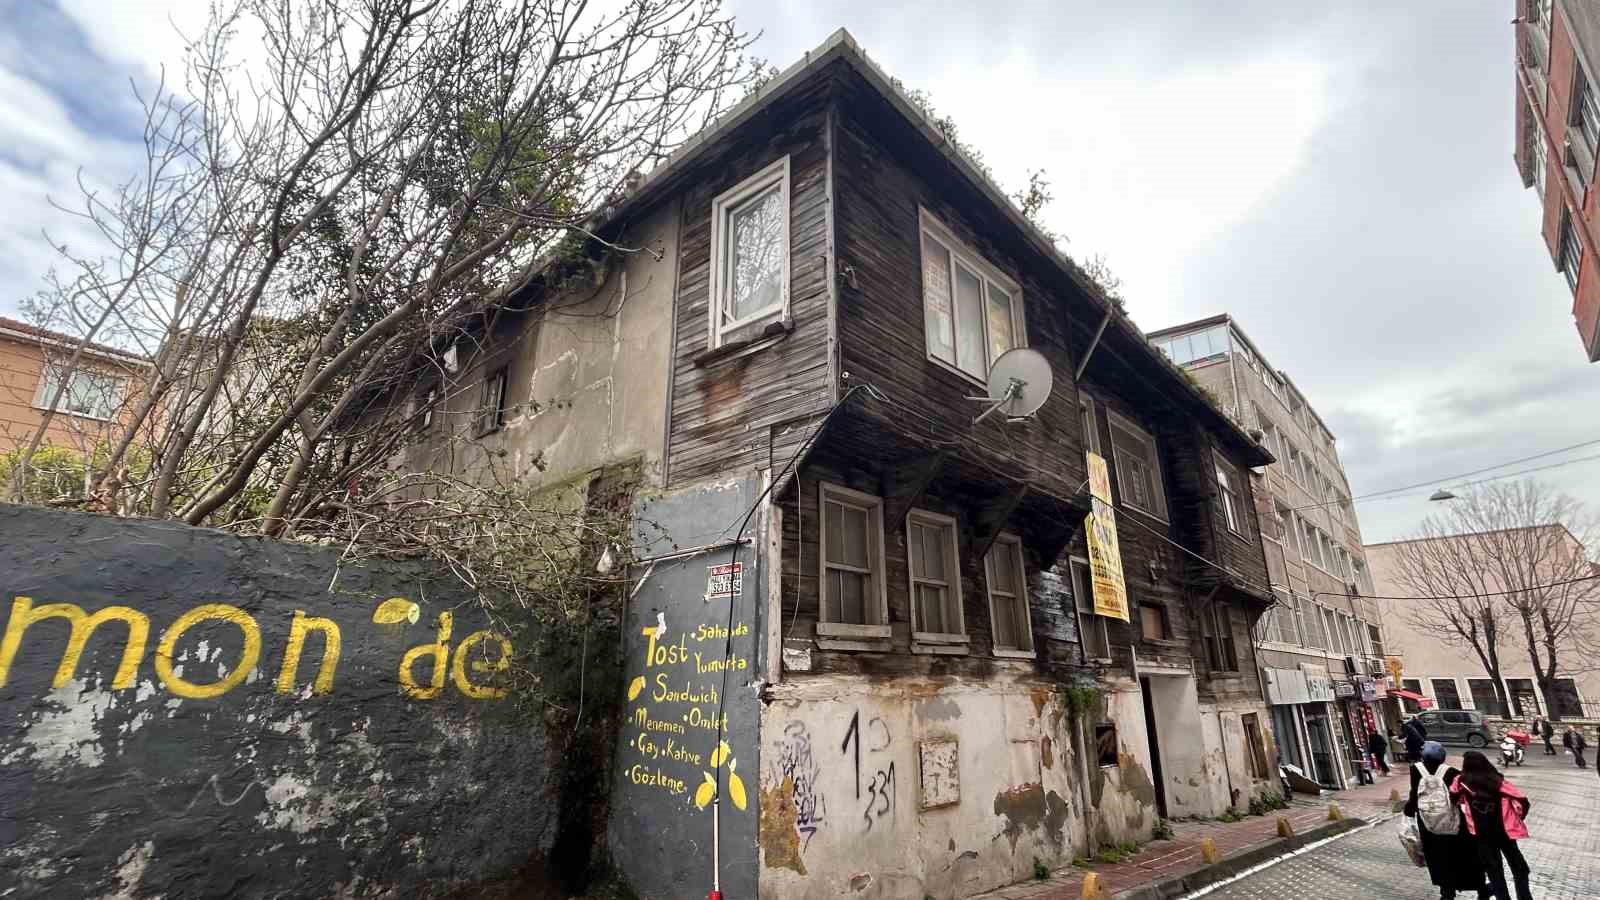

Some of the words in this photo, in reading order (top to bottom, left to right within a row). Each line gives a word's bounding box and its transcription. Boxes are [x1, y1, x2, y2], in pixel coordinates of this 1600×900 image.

[400, 610, 513, 700] de
[642, 626, 688, 667] Tost
[694, 652, 747, 674] Yumurta
[653, 672, 718, 704] Sandwich
[635, 707, 685, 735] Menemen
[689, 707, 728, 733] Omlet
[638, 733, 659, 759] Çay
[667, 738, 702, 765] Kahve
